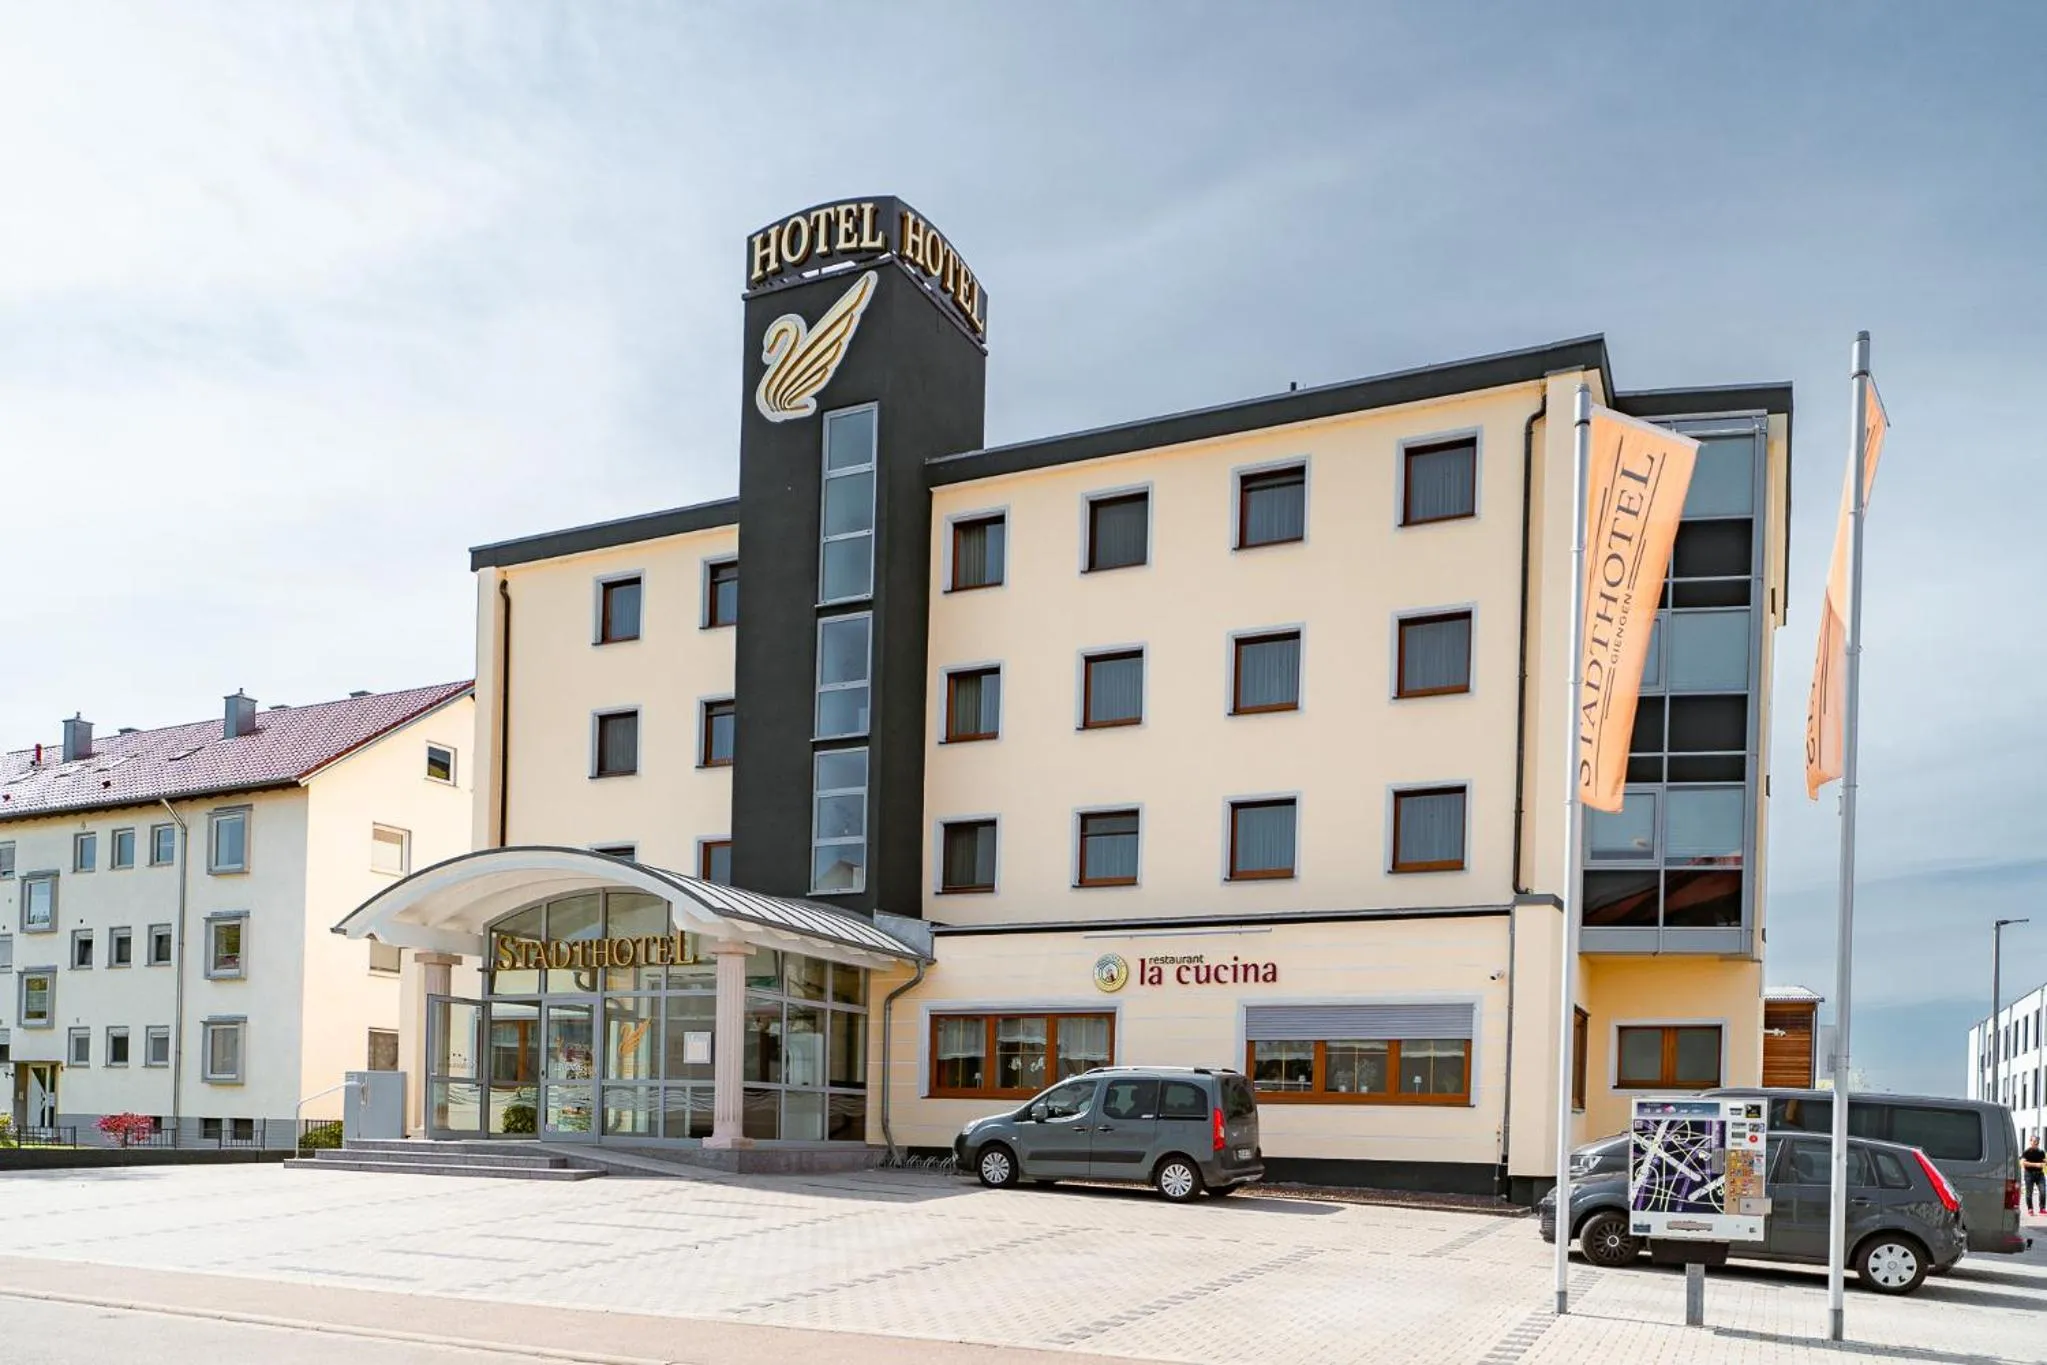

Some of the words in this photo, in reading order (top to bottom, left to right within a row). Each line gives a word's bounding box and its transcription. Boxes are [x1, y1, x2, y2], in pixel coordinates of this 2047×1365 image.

[751, 202, 885, 282] HOTEL
[901, 210, 984, 334] HOTEL
[1611, 593, 1633, 665] GIENGEN
[498, 930, 696, 969] STADTHOTEL
[1139, 958, 1163, 986] la
[1175, 955, 1278, 985] cucina
[1148, 954, 1204, 965] restaurant
